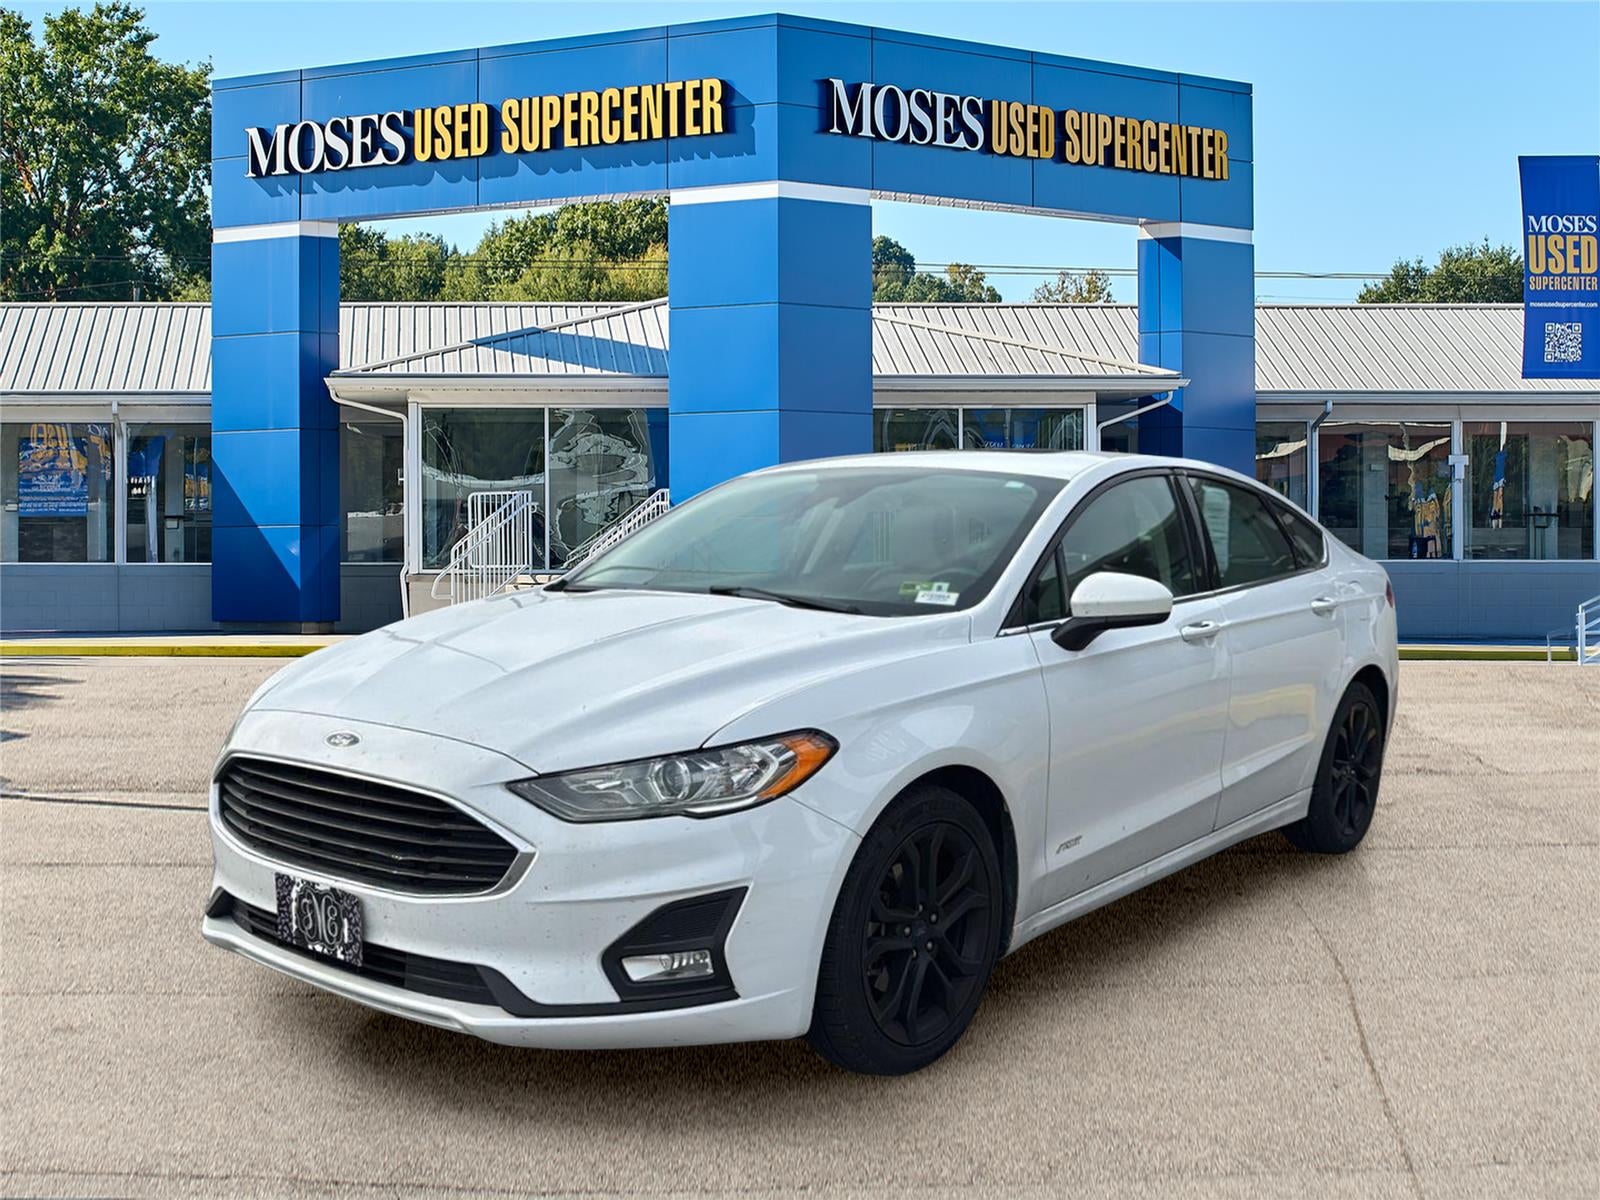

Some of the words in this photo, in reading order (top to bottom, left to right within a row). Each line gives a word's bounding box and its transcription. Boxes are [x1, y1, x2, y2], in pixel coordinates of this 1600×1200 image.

[245, 111, 407, 178] MOSES
[413, 103, 489, 162] USED
[501, 78, 724, 154] SUPERCENTER
[828, 78, 985, 151] MOSES
[991, 99, 1056, 159] USED
[1064, 109, 1229, 181] SUPERCENTER
[1528, 214, 1597, 233] MOSES
[1528, 234, 1598, 274] USED
[1529, 276, 1598, 291] SUPERCENTER
